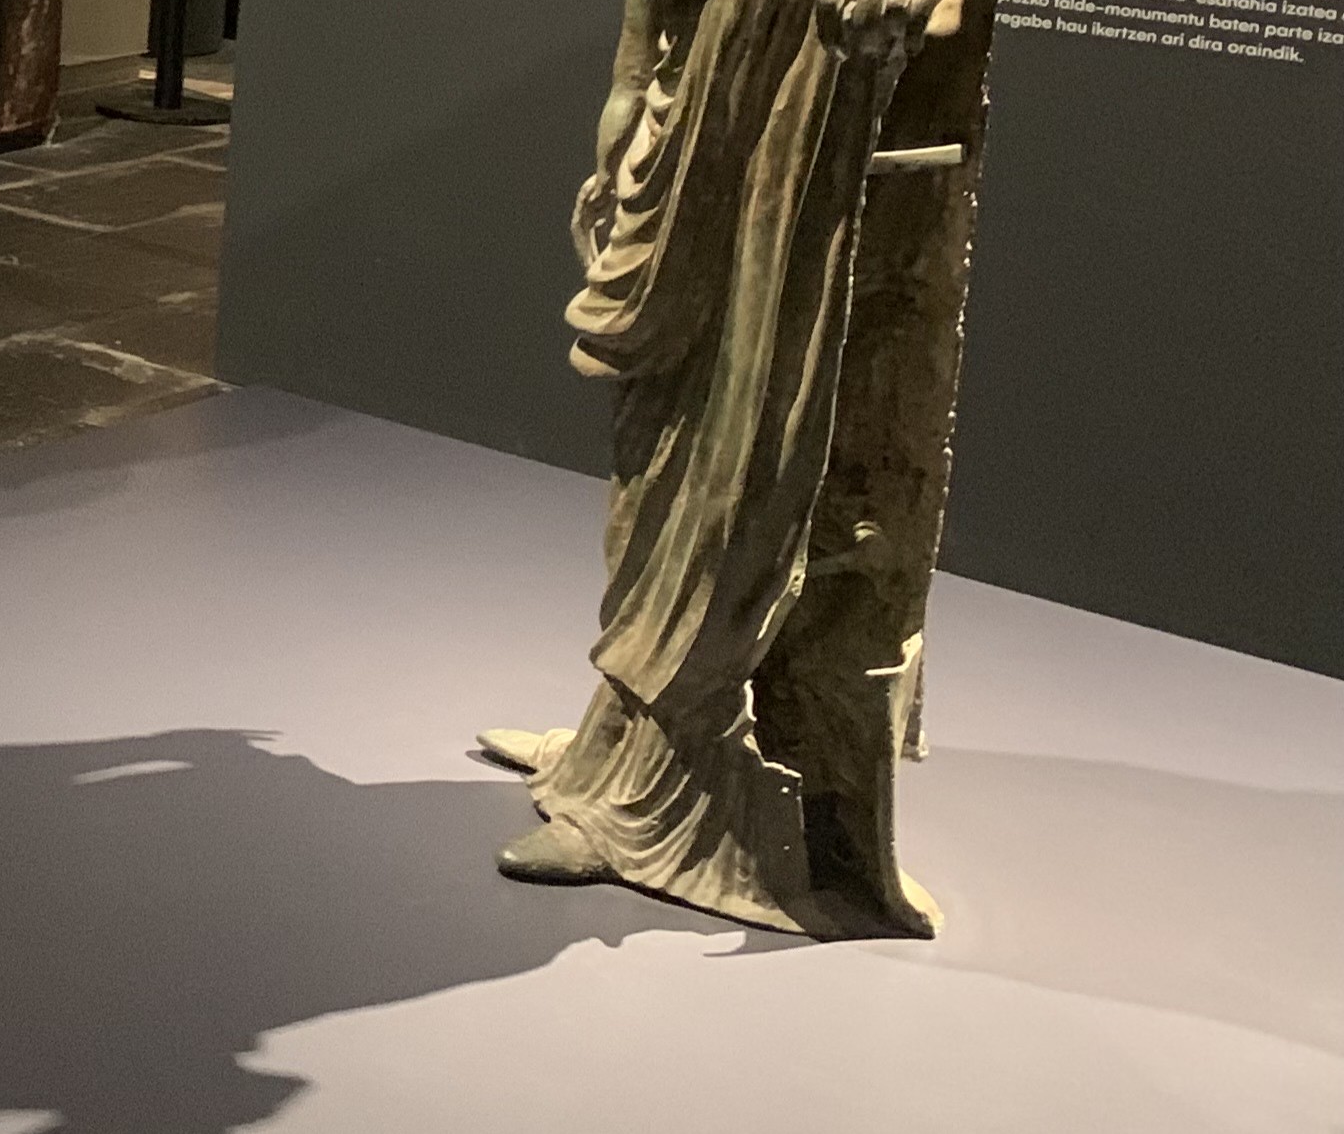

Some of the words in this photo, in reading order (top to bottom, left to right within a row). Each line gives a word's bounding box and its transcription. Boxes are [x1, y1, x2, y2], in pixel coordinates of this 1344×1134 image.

[1056, 17, 1087, 34] hau
[1092, 22, 1156, 42] ikertzen
[1161, 33, 1184, 46] ari
[1188, 35, 1222, 51] dira
[1228, 43, 1304, 62] oraindik.
